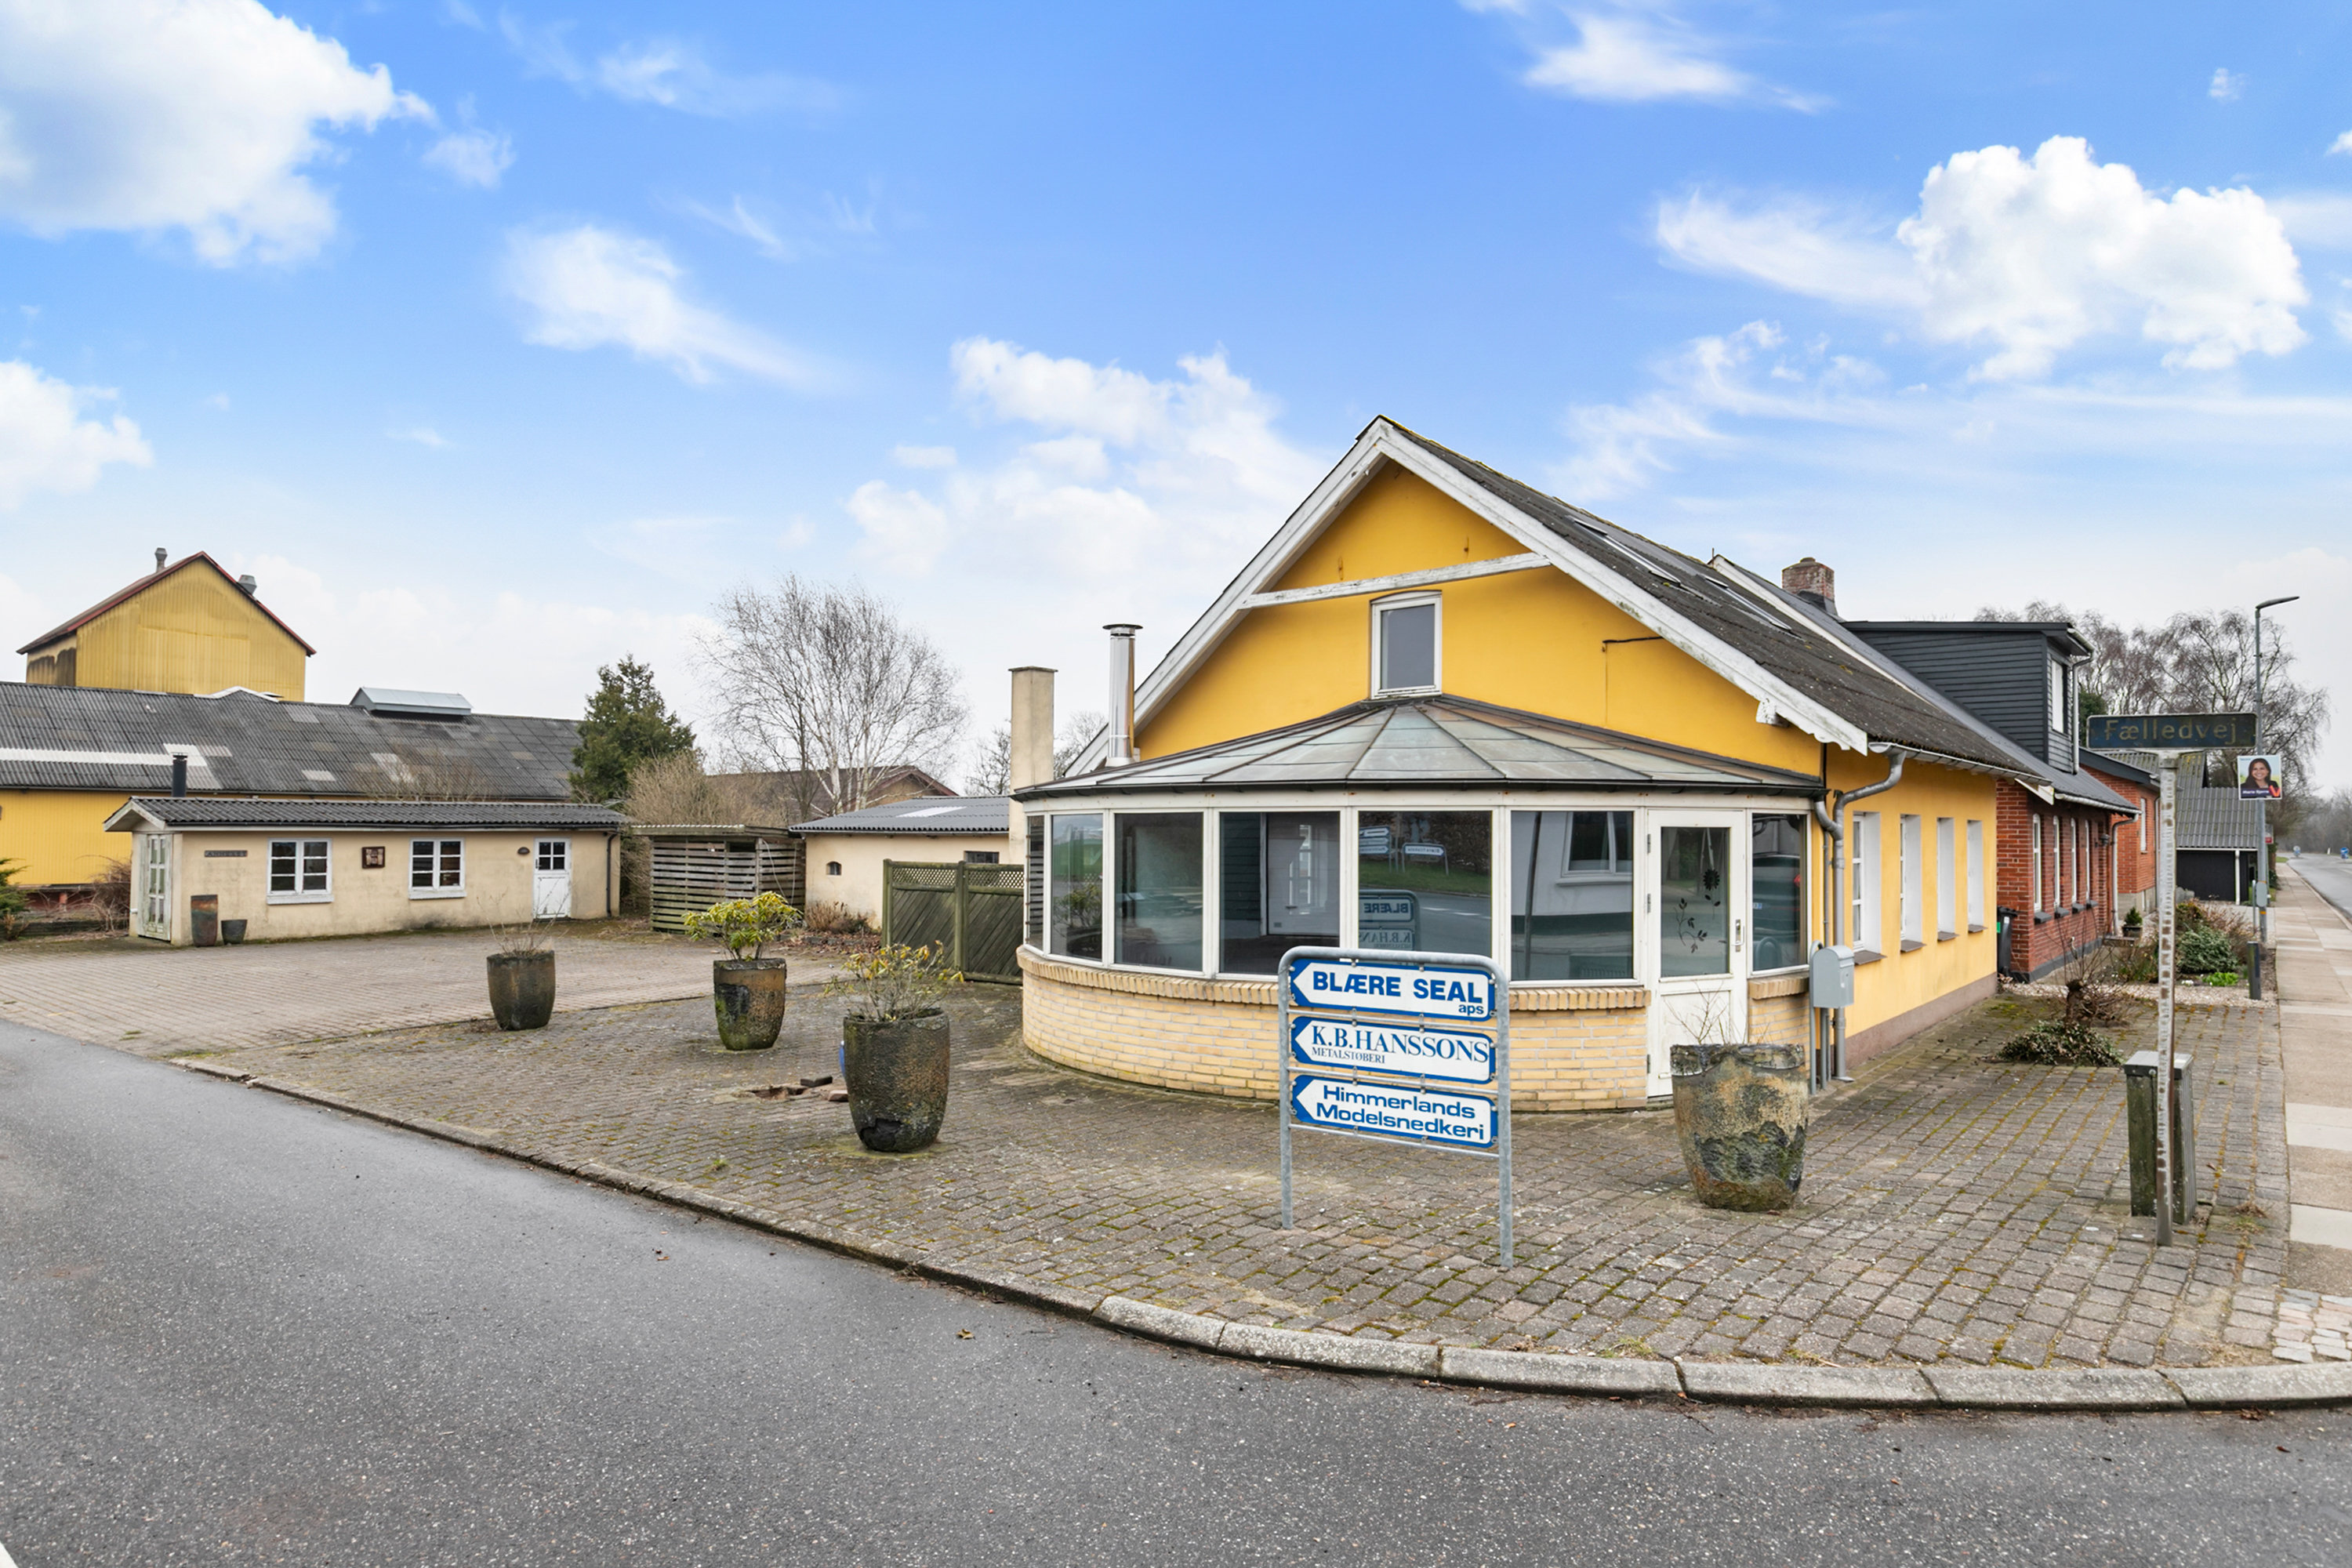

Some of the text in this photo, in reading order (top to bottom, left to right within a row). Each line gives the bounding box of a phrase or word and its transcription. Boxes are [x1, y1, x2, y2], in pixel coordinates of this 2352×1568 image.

[2104, 719, 2236, 743] Fælledvej
[1312, 971, 1483, 1004] BLÆRE SEAL
[1458, 1004, 1484, 1015] aps
[1312, 1047, 1385, 1064] METALSTØBERI
[1323, 1084, 1475, 1119] Himmerlands
[1316, 1102, 1484, 1140] Modelsnedkeri
